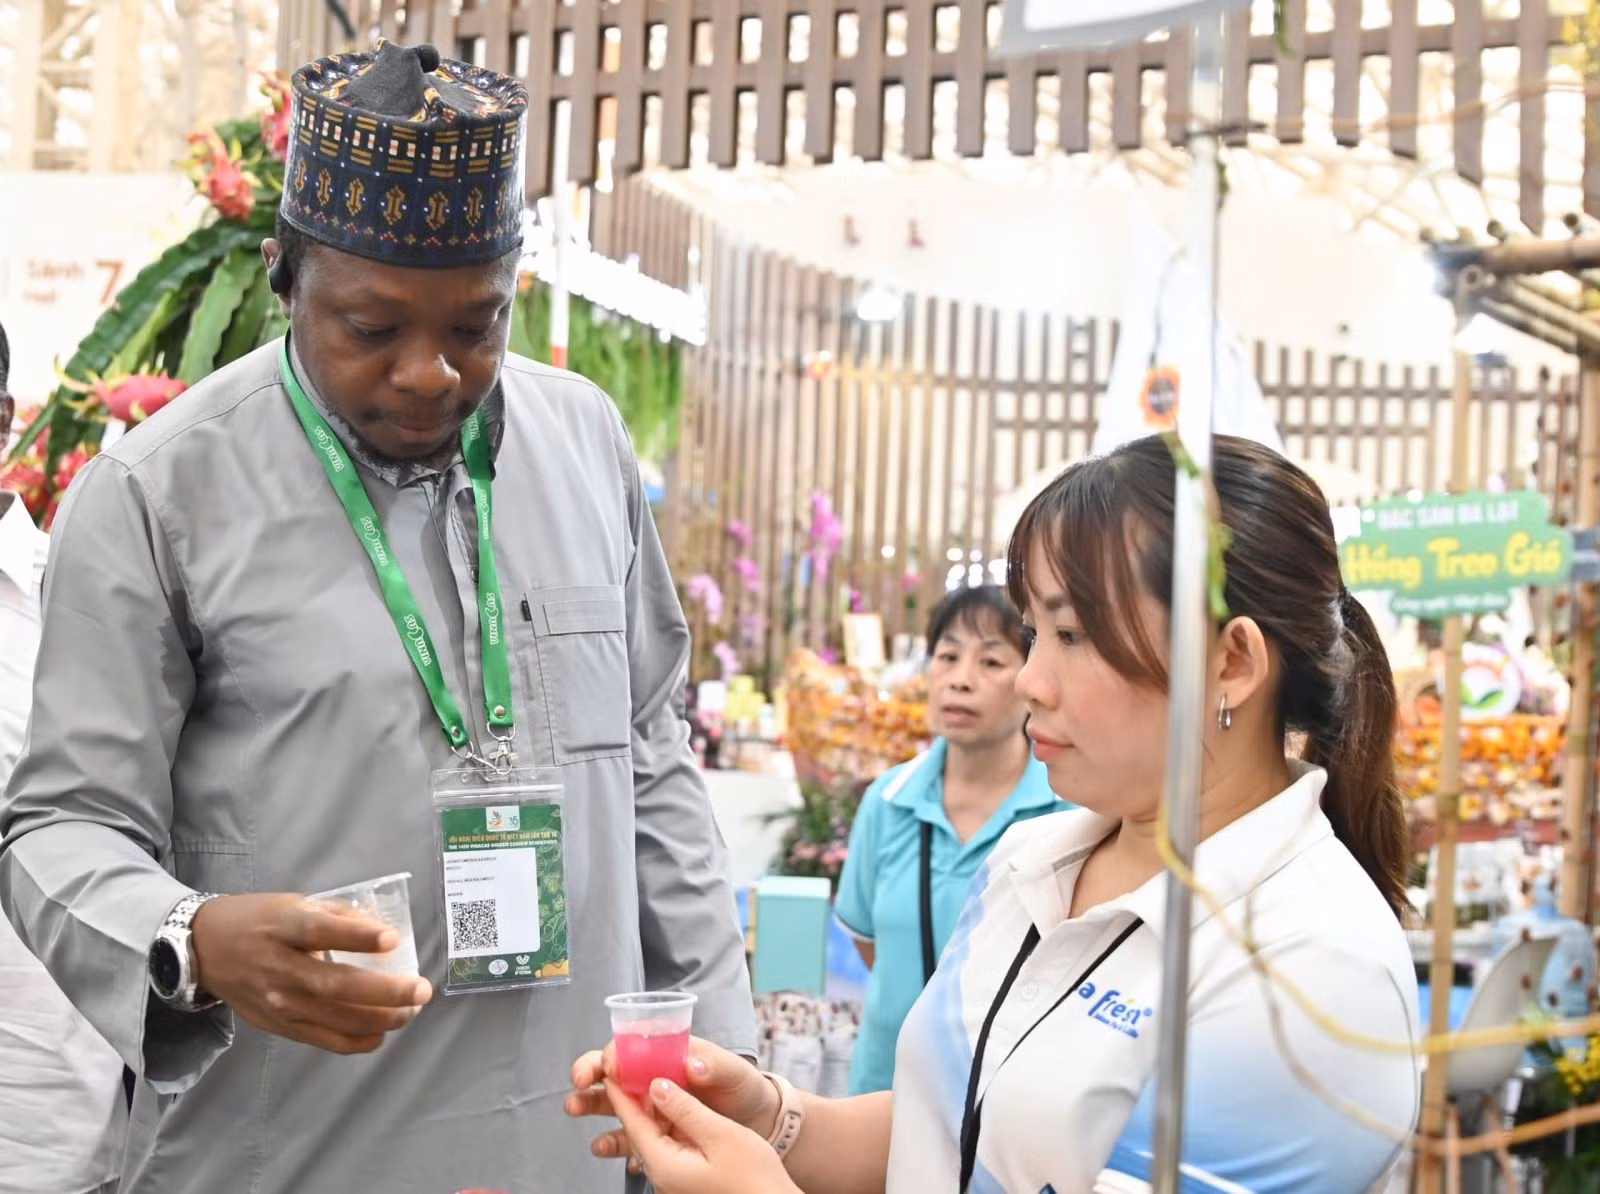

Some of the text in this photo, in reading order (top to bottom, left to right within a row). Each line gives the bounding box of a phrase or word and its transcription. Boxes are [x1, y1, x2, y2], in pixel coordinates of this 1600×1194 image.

[96, 259, 123, 304] 7
[1427, 537, 1498, 579] Treo
[1505, 531, 1562, 576] Gió
